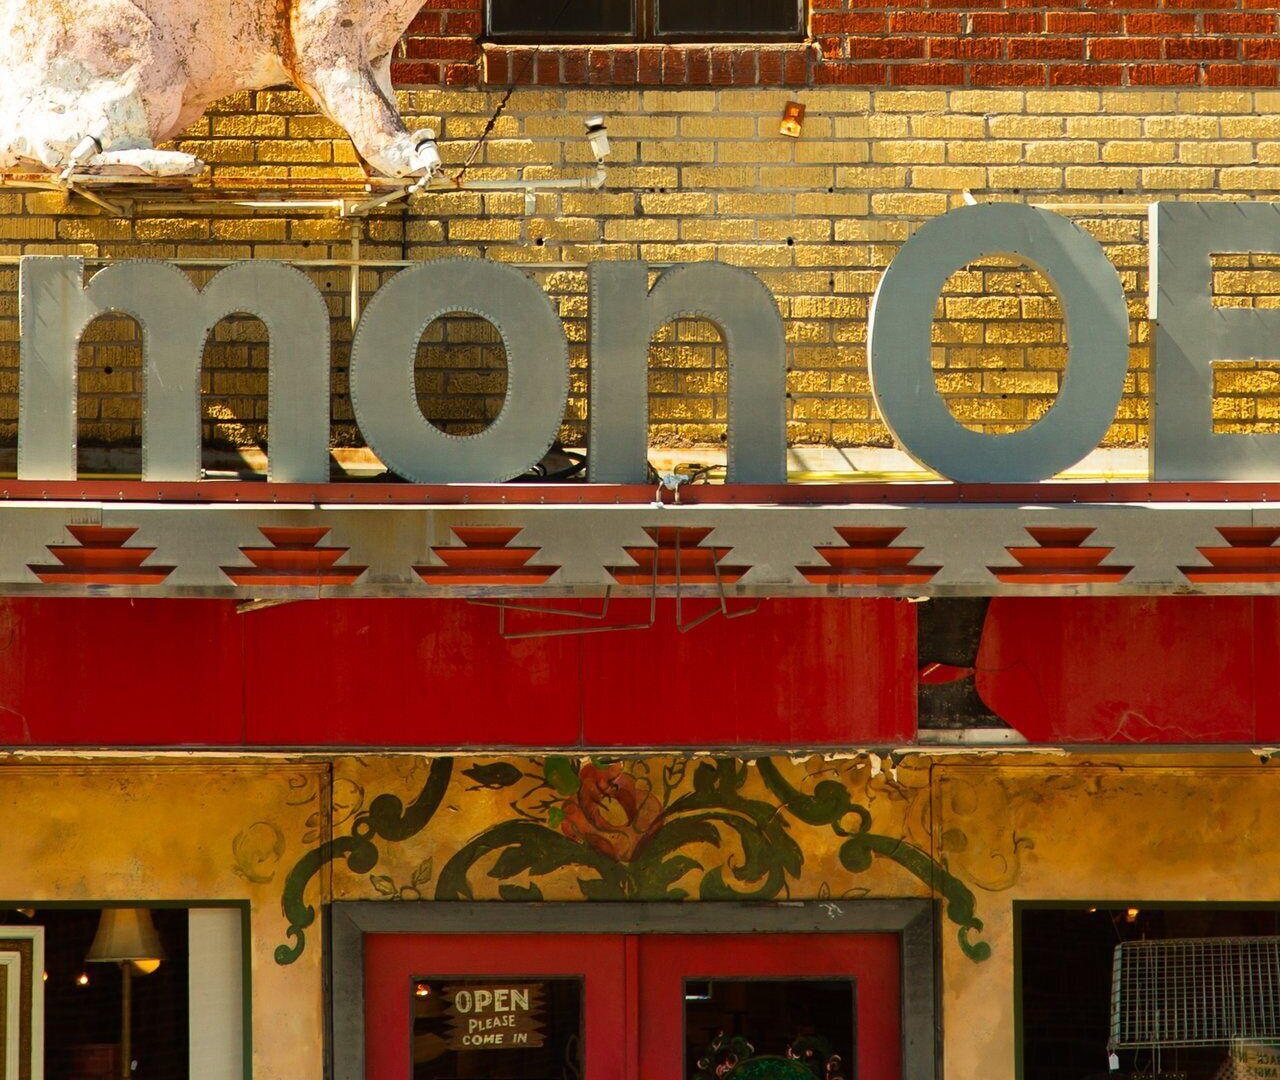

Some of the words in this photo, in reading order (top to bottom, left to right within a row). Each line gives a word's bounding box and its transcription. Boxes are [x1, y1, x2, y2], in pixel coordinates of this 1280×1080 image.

[455, 989, 529, 1013] OPEN
[468, 1015, 516, 1034] PLEASE
[462, 1034, 504, 1045] COME
[512, 1033, 528, 1043] IN
